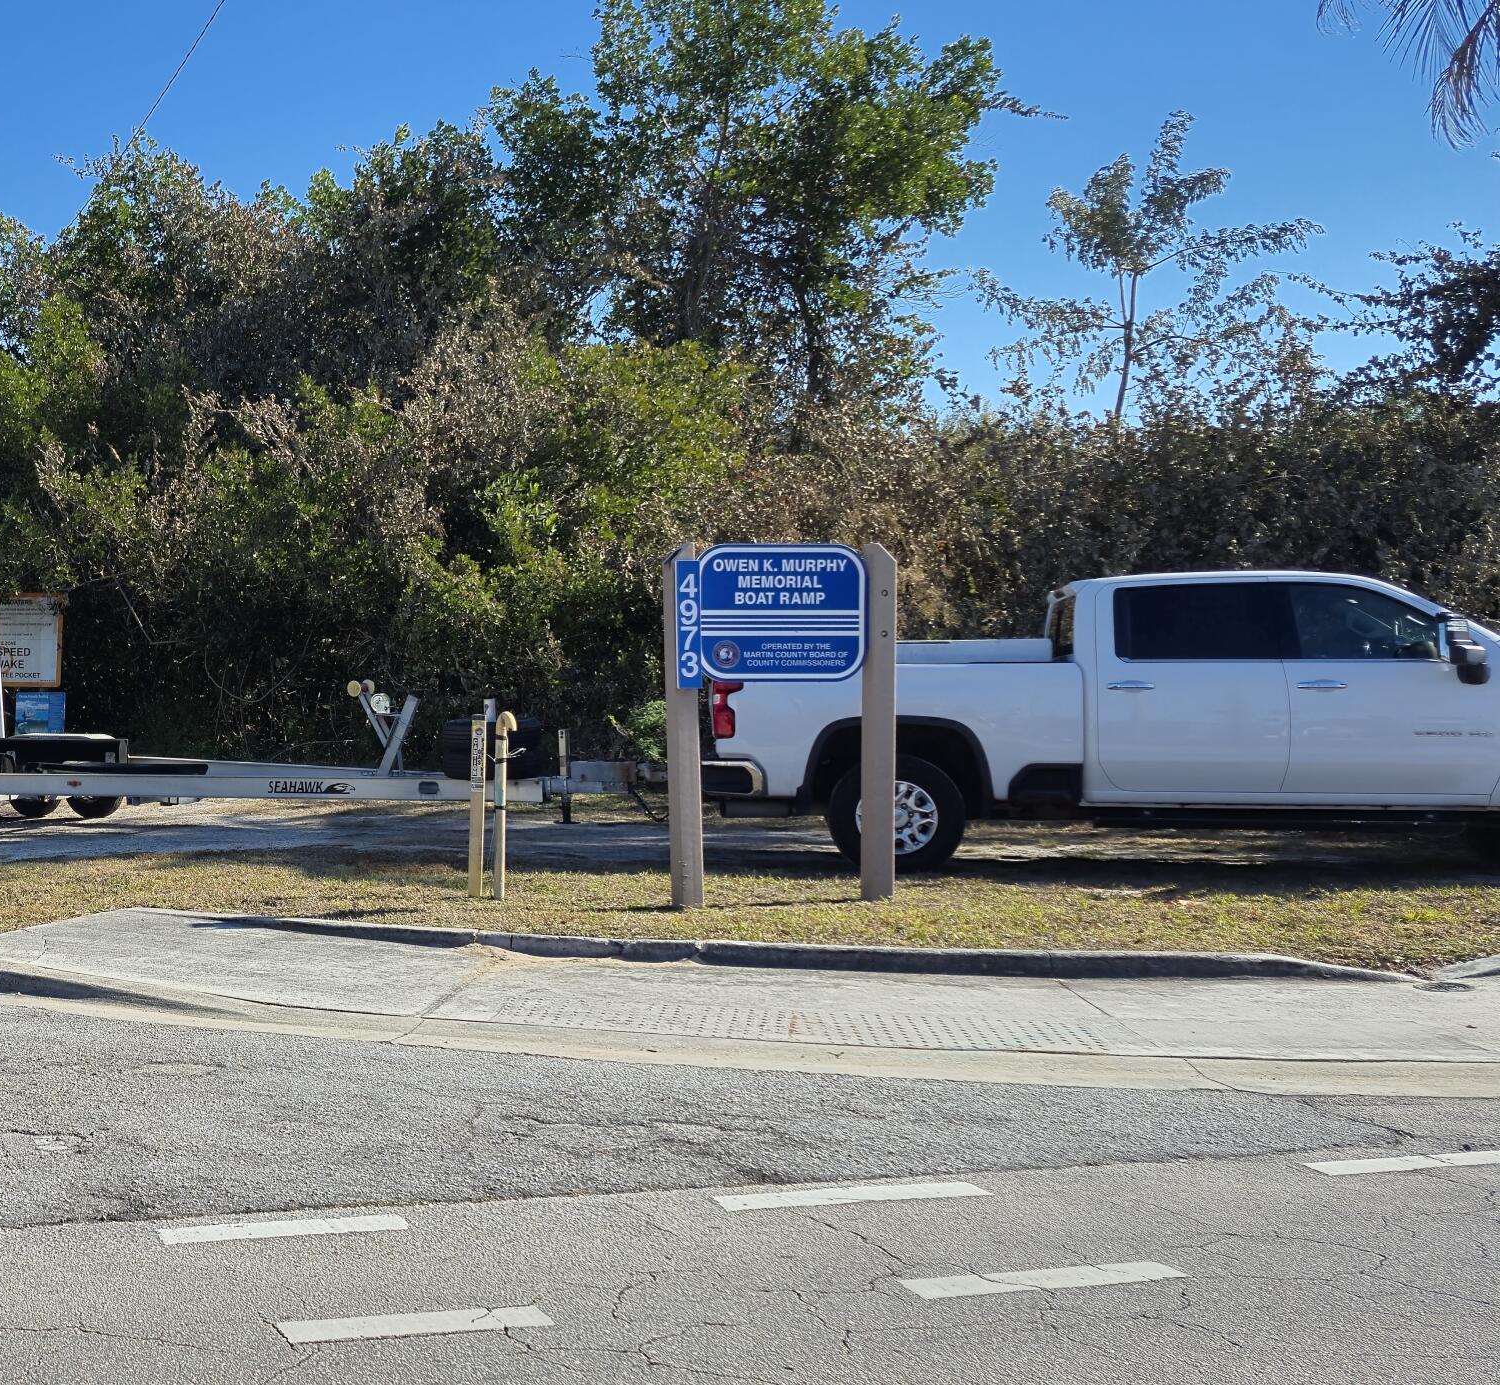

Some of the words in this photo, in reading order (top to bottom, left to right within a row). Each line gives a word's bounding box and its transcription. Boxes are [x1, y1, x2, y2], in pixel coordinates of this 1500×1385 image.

[713, 559, 759, 572] OWEN
[763, 559, 778, 572] K.
[782, 559, 847, 572] MURPHY
[738, 575, 823, 588] MEMORIAL
[734, 592, 775, 605] BOAT
[780, 592, 826, 605] RAMP
[679, 573, 699, 678] 4973
[0, 647, 31, 656] SPEED
[268, 781, 324, 794] SEAHAWK
